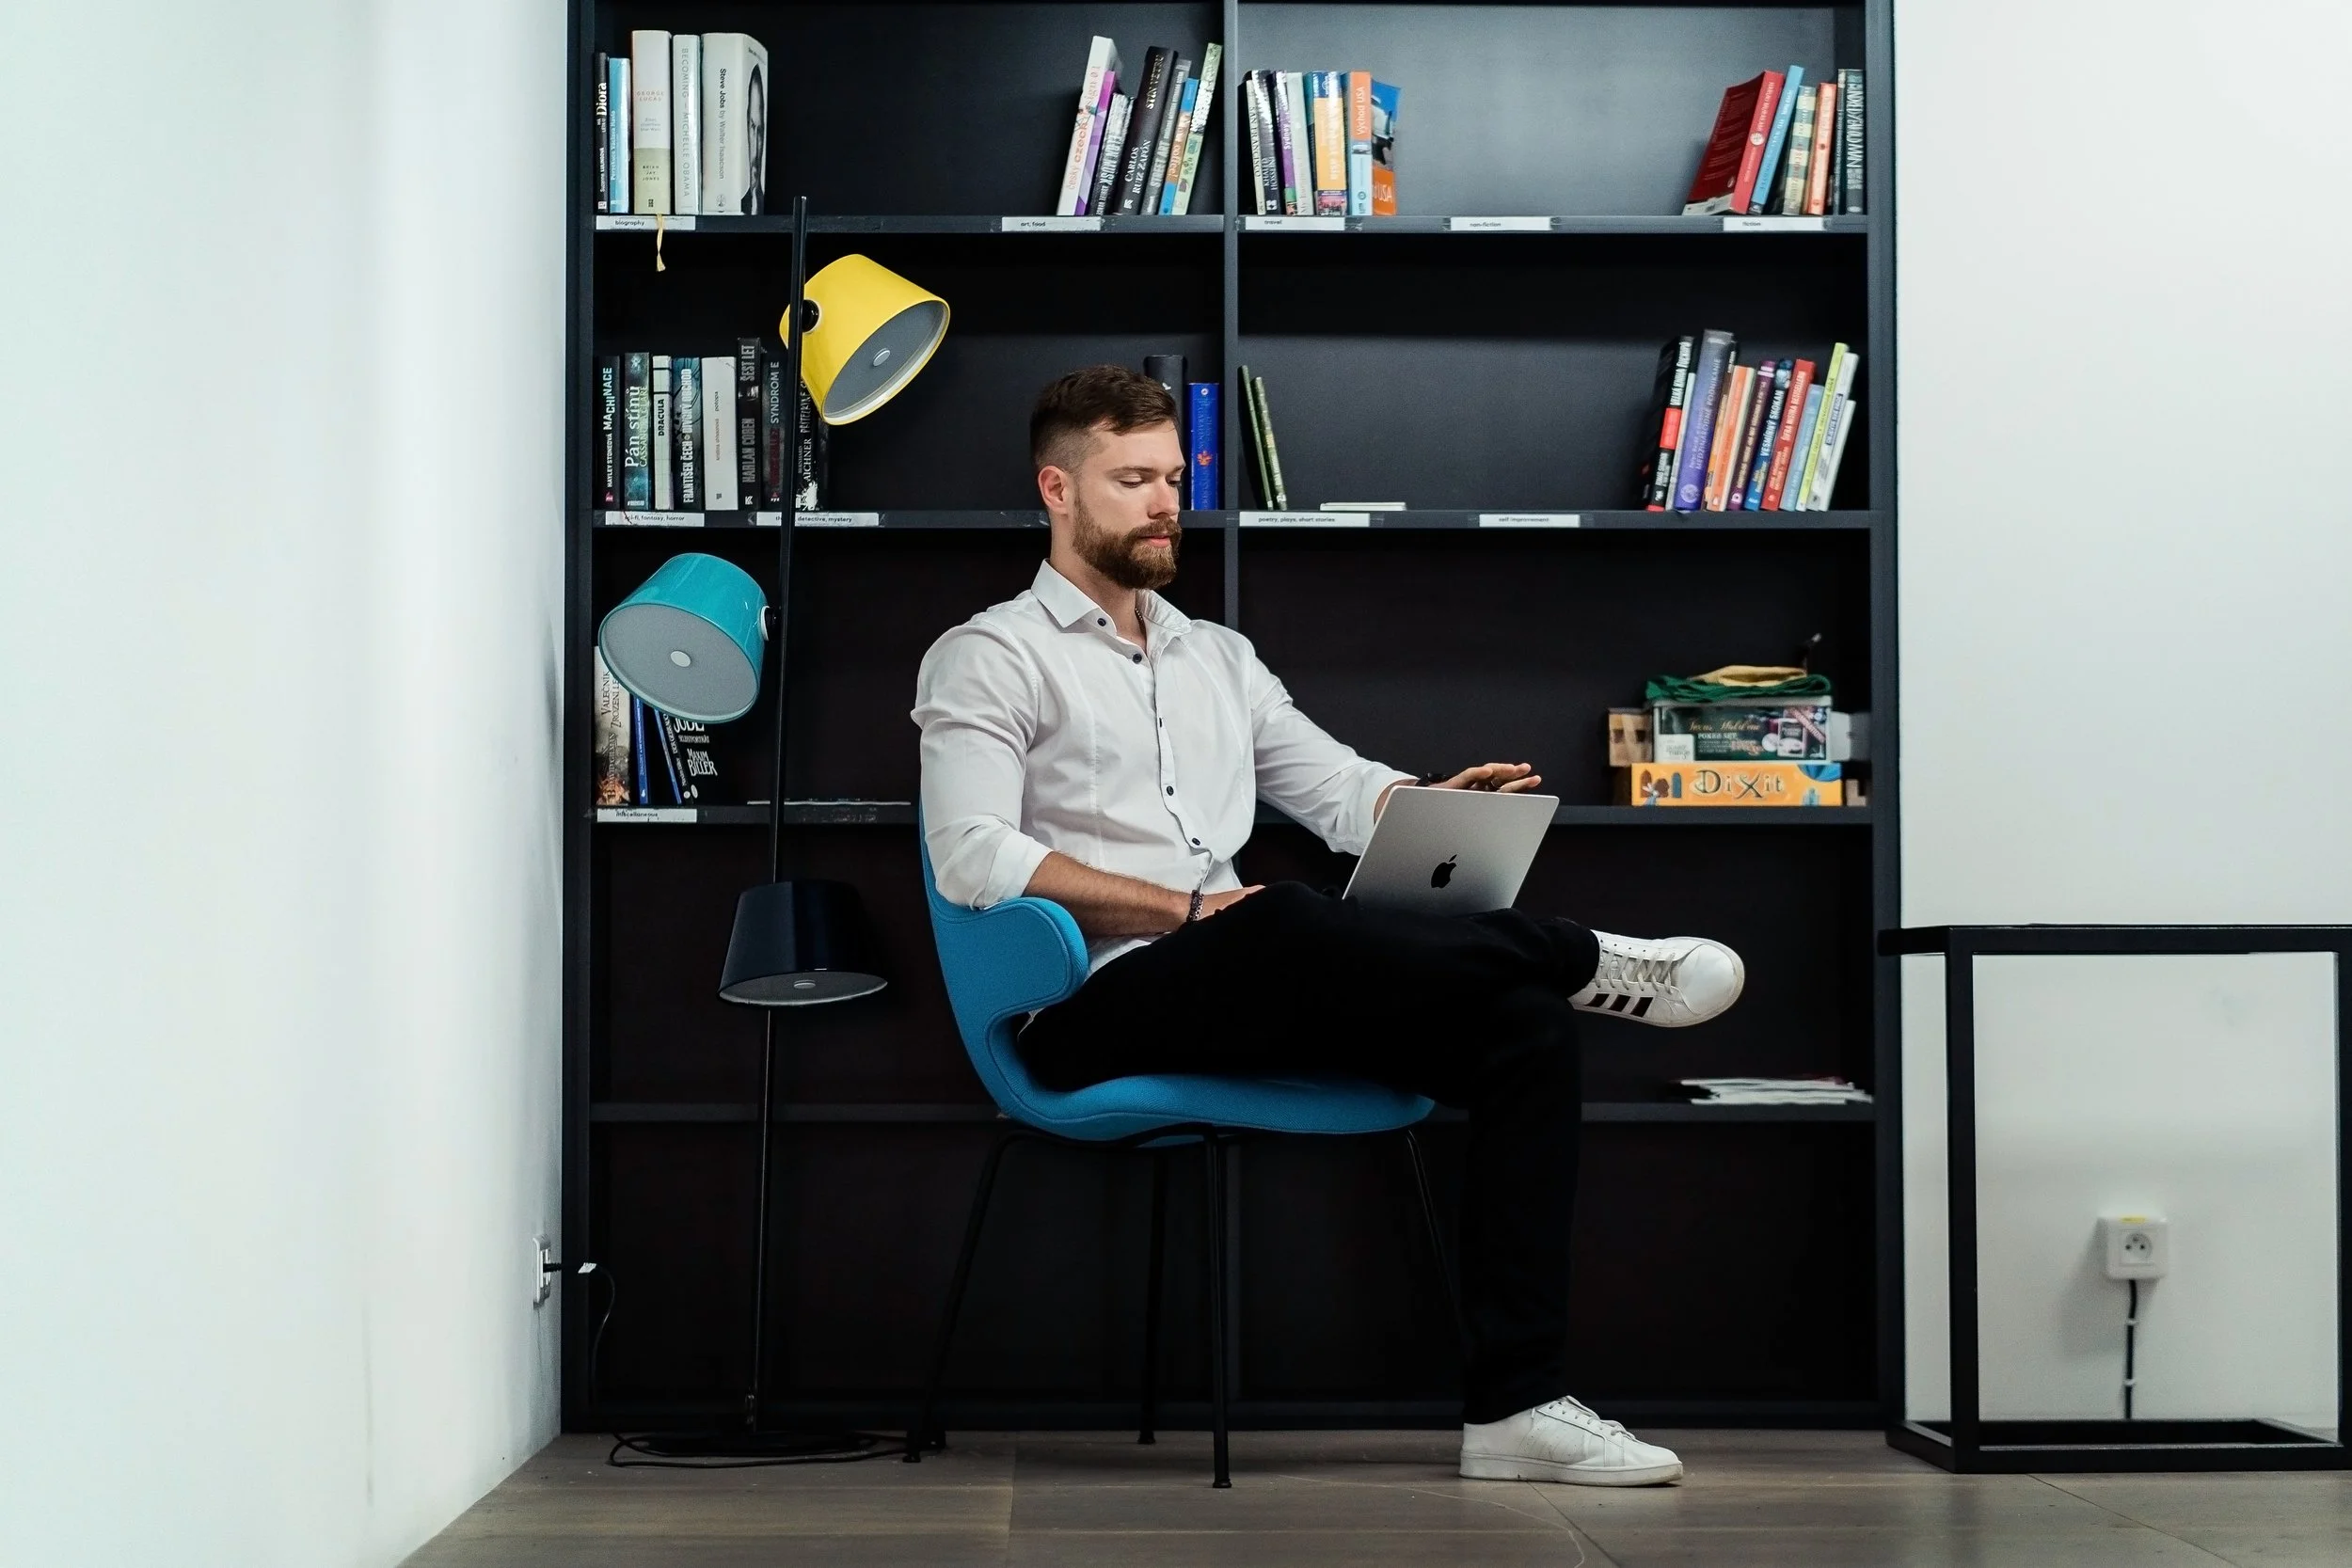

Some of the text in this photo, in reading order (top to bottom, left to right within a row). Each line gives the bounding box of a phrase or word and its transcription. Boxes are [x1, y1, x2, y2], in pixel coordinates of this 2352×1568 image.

[596, 82, 607, 116] Diora
[718, 110, 726, 119] by
[1356, 87, 1368, 135] Východ USA
[1106, 134, 1123, 157] ELON
[1249, 127, 1261, 178] FRANCISCO
[1282, 123, 1292, 150] Sydney
[682, 163, 691, 197] OBAMA
[1099, 158, 1119, 185] MUSK
[1124, 147, 1139, 182] CARLOS
[1132, 139, 1152, 194] RUIZ ZAFÓN
[1673, 368, 1687, 387] KNIHA
[1706, 357, 1722, 406] PODNIKANIE
[602, 367, 615, 430] MACHINACE
[770, 372, 779, 425] SYNDROM
[1669, 387, 1683, 405] VELKÁ
[625, 386, 640, 467] Pán stínů
[739, 346, 755, 484] HARLAN COBEN ŠEST LET
[1759, 389, 1785, 457] VESMÍRNÝ SKOKAN
[680, 441, 693, 461] ČECH
[803, 439, 811, 483] AICHNER
[681, 462, 694, 503] FRANTIŠEK
[663, 713, 675, 741] GEBRAUC
[687, 759, 718, 777] BILLER
